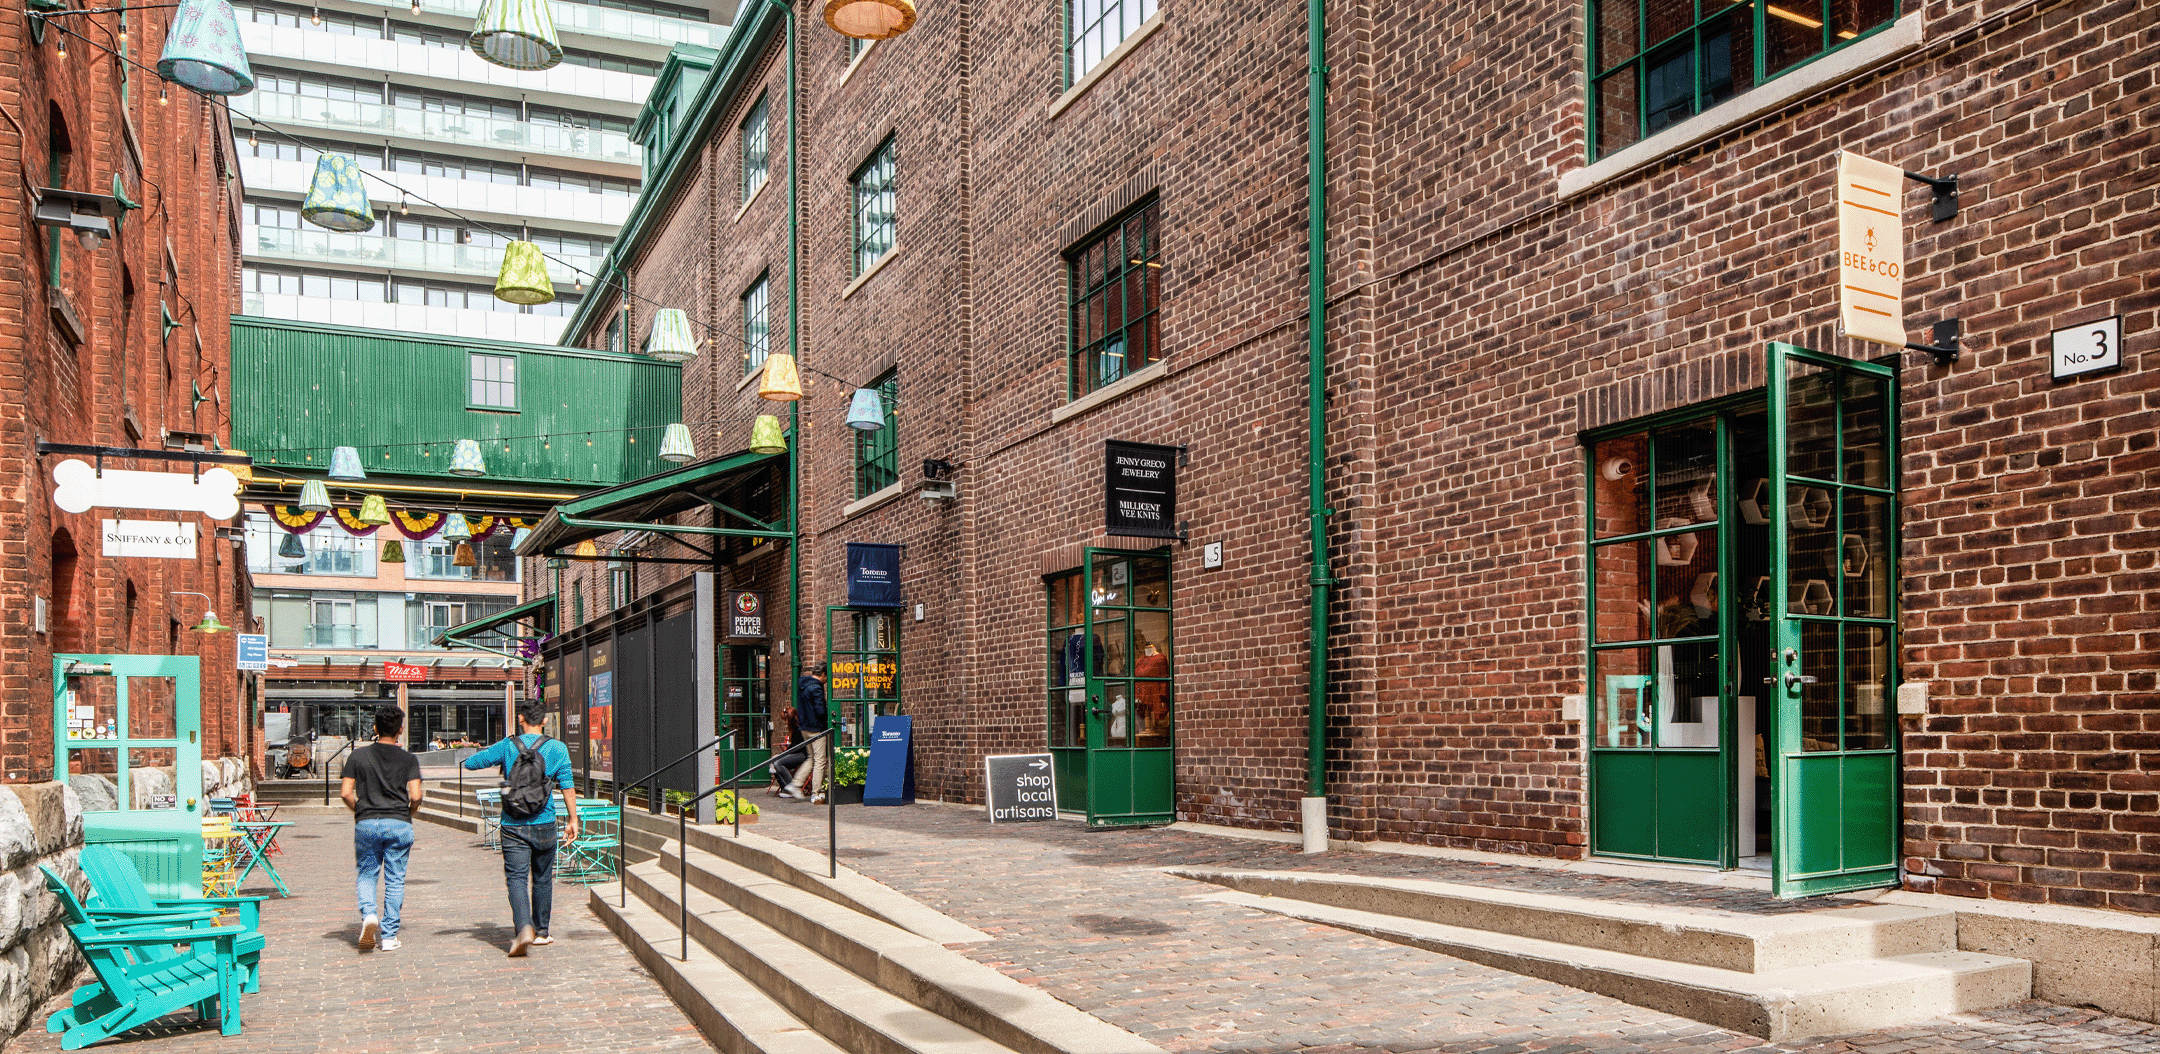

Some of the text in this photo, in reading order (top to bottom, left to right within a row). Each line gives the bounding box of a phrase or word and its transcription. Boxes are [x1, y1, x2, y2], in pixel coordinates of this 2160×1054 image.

[2064, 329, 2108, 366] No. 3
[1116, 456, 1166, 469] JENNY GRECO
[1121, 467, 1160, 479] JEWELERY
[1119, 500, 1161, 512] MILLICENT
[1120, 508, 1160, 520] VEE KNITS
[163, 536, 172, 545] &
[1213, 546, 1219, 562] 5
[860, 567, 888, 576] Toronto
[735, 616, 761, 626] PEPPER
[735, 625, 761, 635] PALACE
[877, 618, 885, 649] OPEN
[387, 665, 410, 675] Mill
[831, 662, 897, 675] MOTHER'S
[832, 677, 859, 689] DAY
[863, 675, 893, 683] SUNDAY
[1016, 773, 1050, 789] shop
[1017, 788, 1051, 802] local
[995, 805, 1053, 819] artisans
